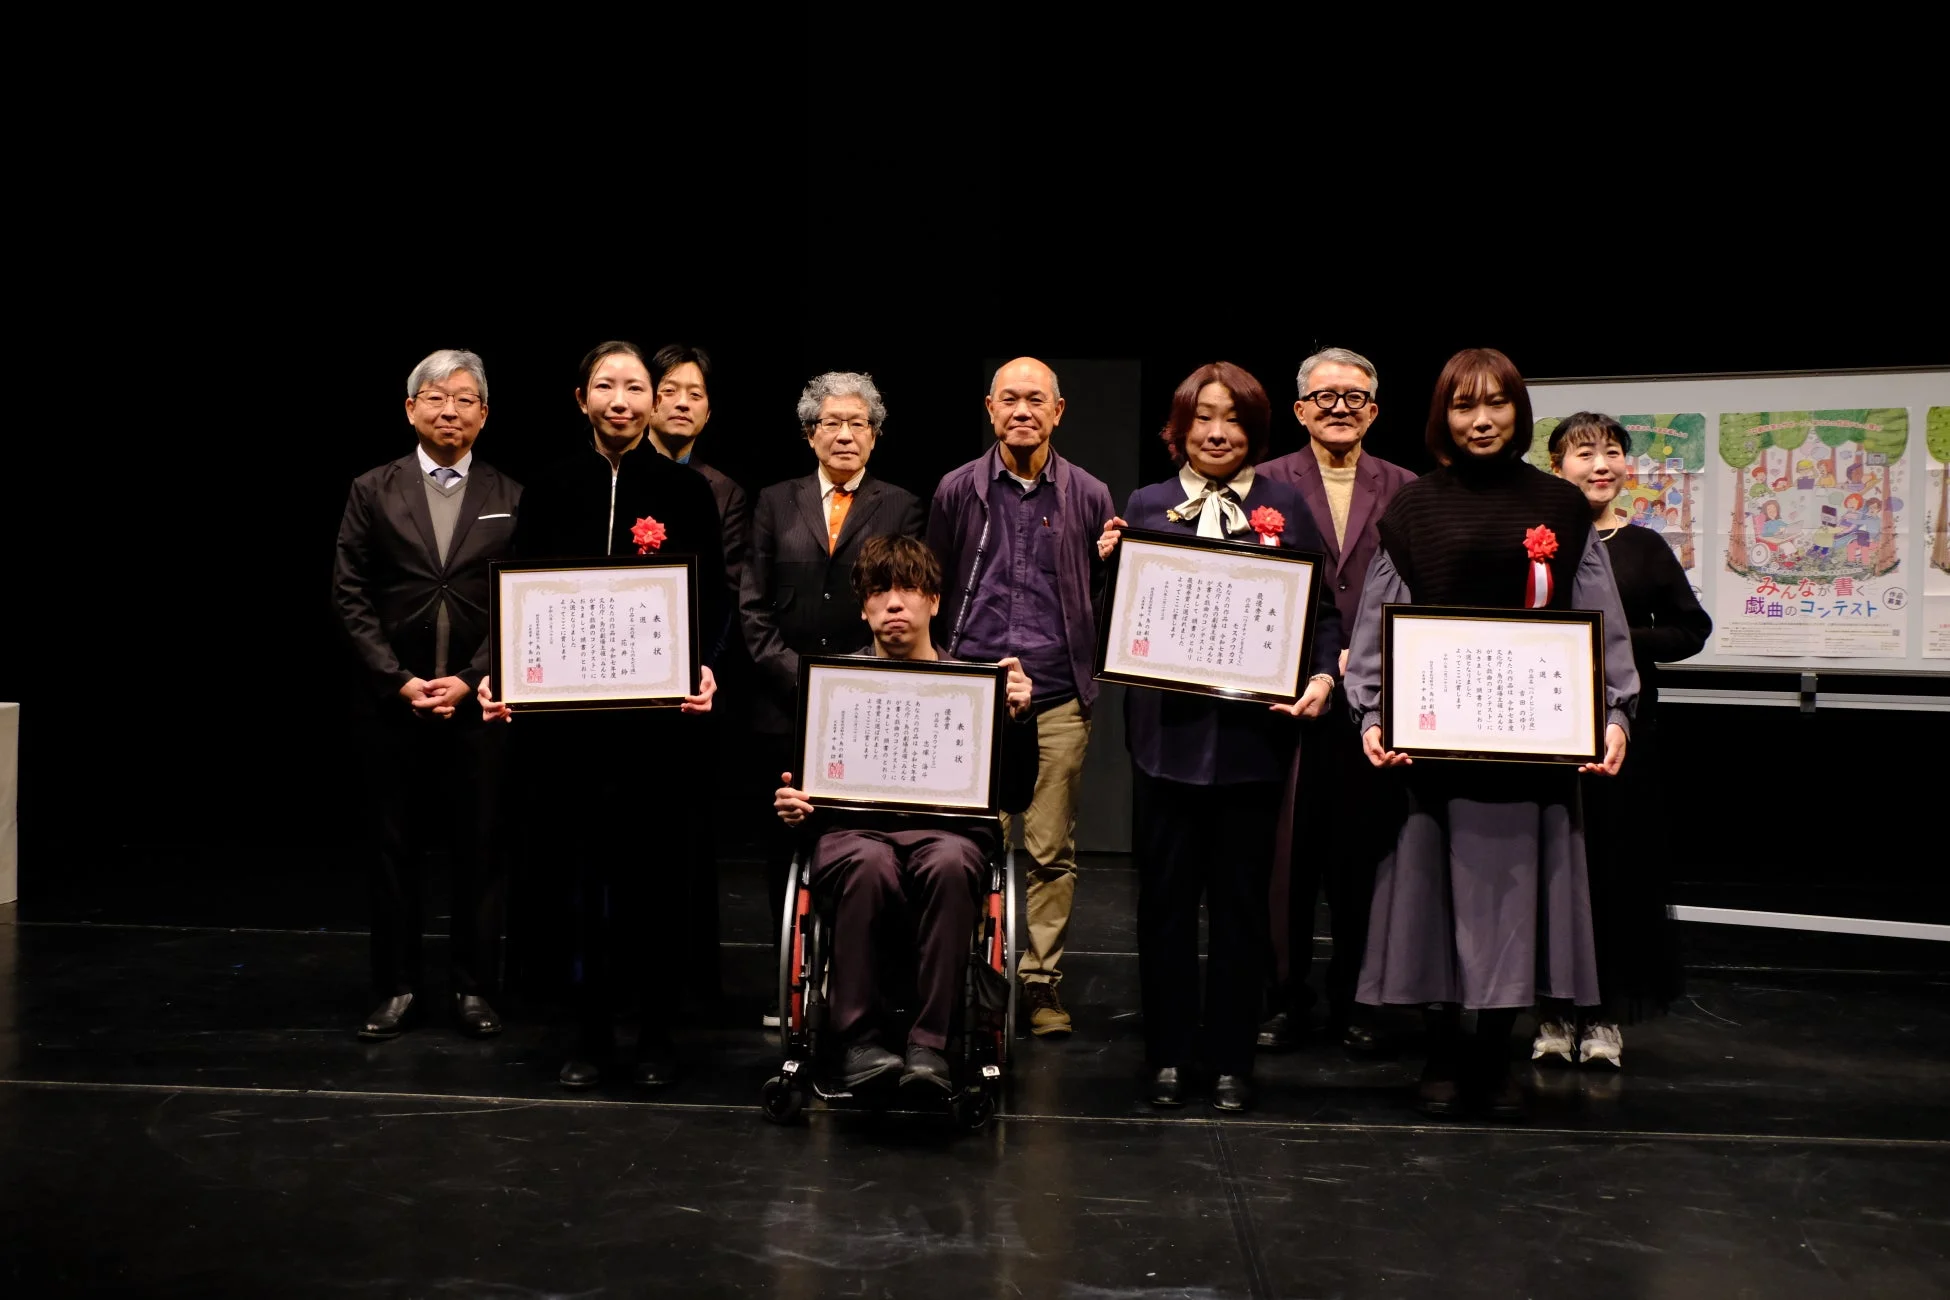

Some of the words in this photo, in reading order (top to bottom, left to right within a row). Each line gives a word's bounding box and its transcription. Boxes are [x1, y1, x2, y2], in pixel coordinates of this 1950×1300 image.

[1756, 576, 1866, 600] みんなが書く
[1888, 591, 1904, 600] 作品
[639, 602, 647, 624] 入選
[1744, 596, 1878, 619] 戯曲のコンテスト
[653, 614, 662, 656] 表彰状
[1263, 607, 1278, 650] 表彰状
[1538, 656, 1547, 679] 入選
[1552, 670, 1563, 712] 表彰状
[954, 722, 966, 764] 表彰状
